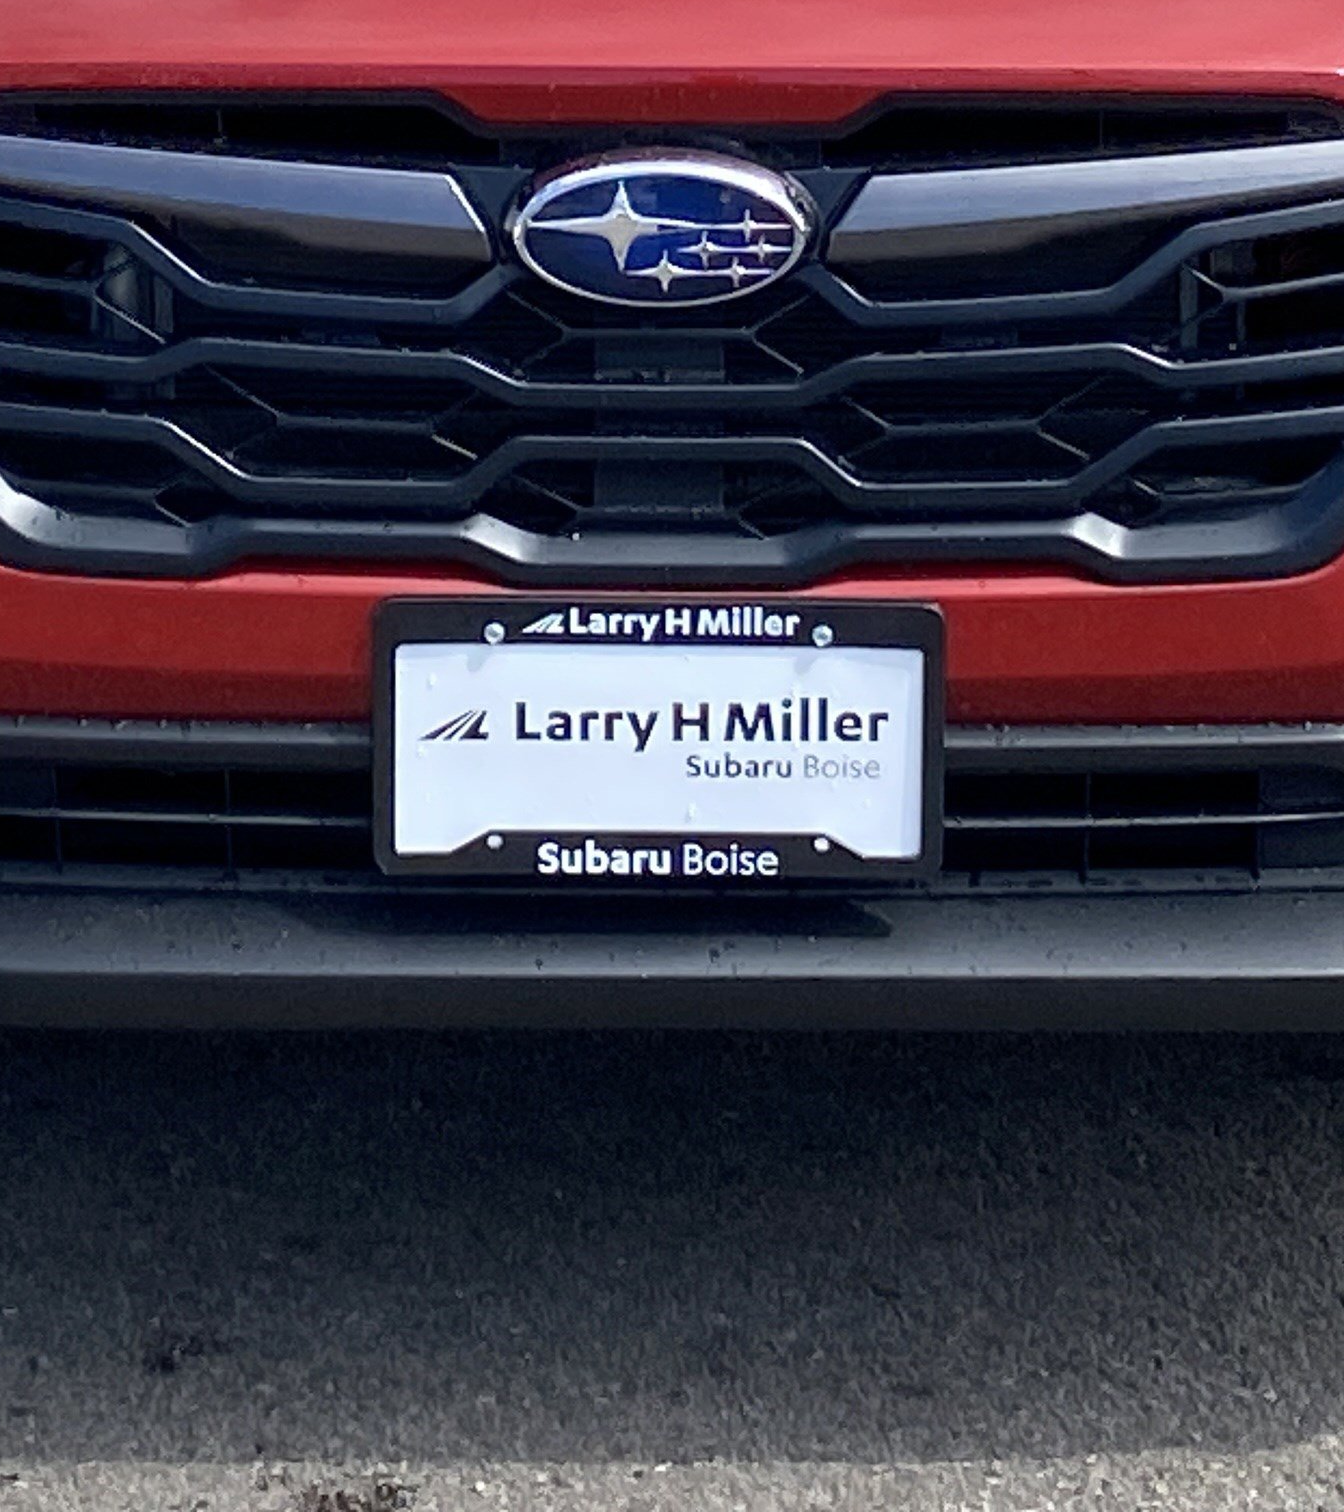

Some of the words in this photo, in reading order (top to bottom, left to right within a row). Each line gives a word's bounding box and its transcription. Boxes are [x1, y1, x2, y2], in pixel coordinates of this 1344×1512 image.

[568, 606, 661, 642] Larry
[665, 608, 691, 636] H
[697, 606, 801, 637] Miller
[515, 701, 658, 753] Larry
[672, 702, 710, 742] H
[723, 697, 889, 743] Miller
[685, 753, 793, 779] Subaru
[803, 754, 881, 779] Boise
[537, 839, 671, 875] Subaru
[683, 843, 780, 877] Boise
